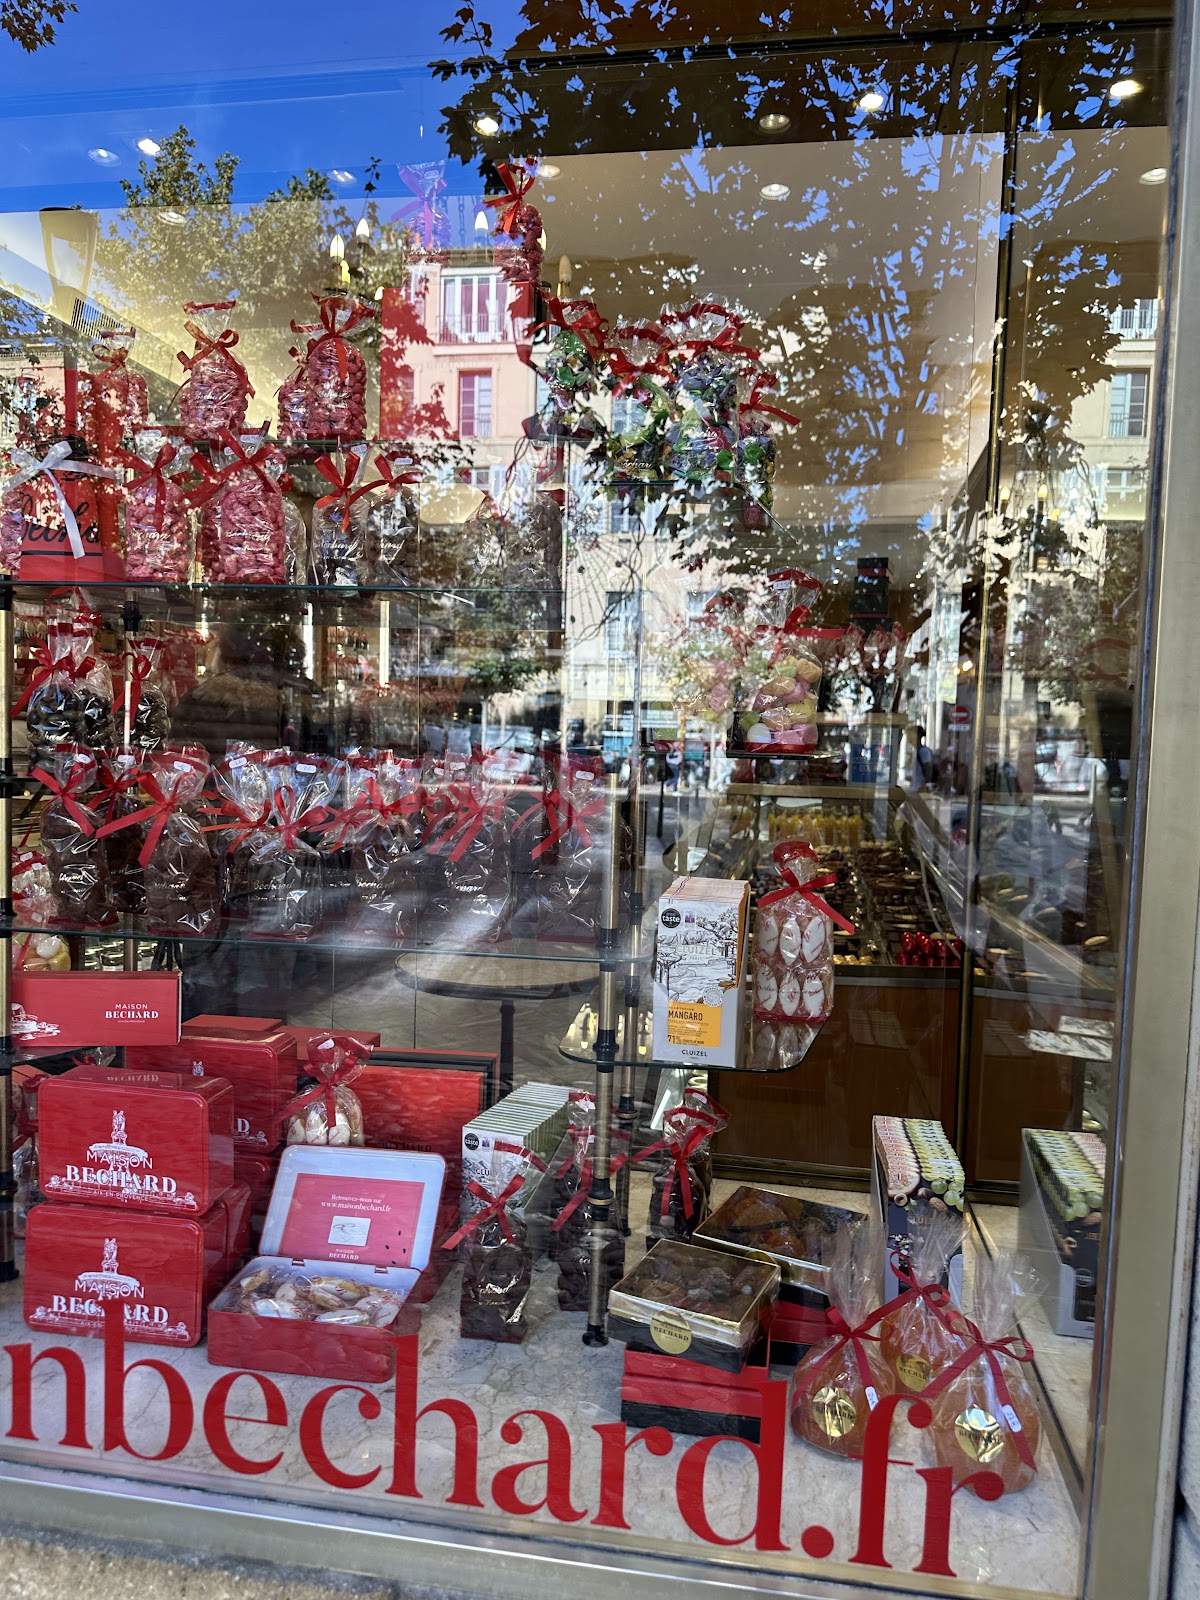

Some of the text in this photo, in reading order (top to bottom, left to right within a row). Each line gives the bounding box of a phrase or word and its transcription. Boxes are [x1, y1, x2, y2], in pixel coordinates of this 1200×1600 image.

[676, 945, 717, 956] CLUIZEL
[105, 1010, 159, 1019] BECHARD
[668, 1010, 703, 1021] MANGARO
[681, 1049, 707, 1057] CLUIZEL
[86, 1150, 153, 1169] MAISON
[66, 1165, 177, 1194] BECHARD
[74, 1279, 145, 1299] MAISON
[52, 1295, 169, 1324] BECARD
[653, 1326, 689, 1341] BECHARD
[2, 1299, 1005, 1578] nbechard.fr
